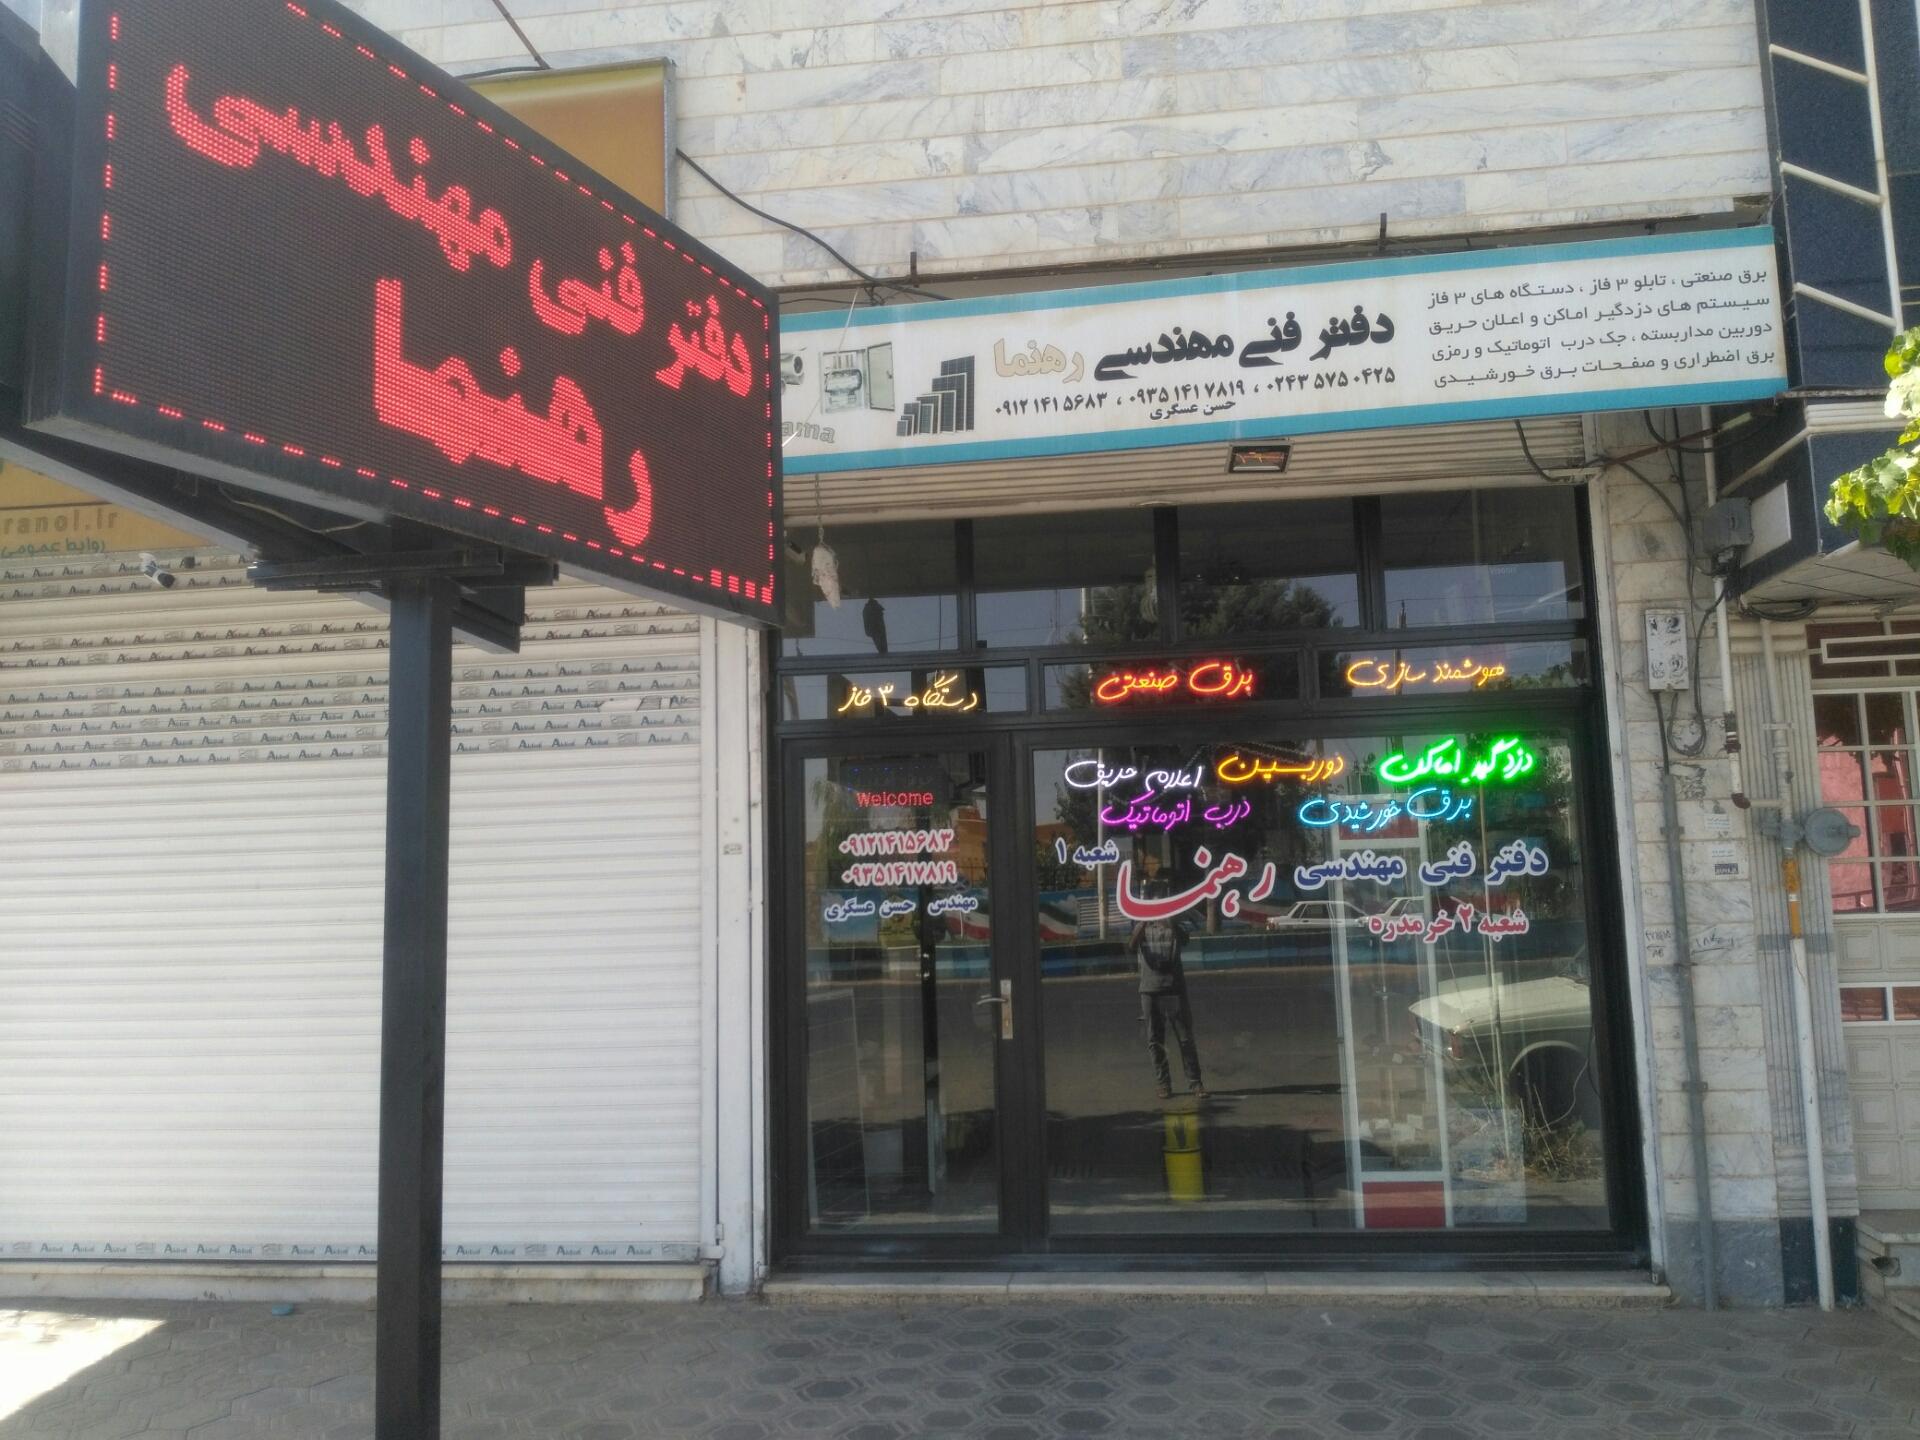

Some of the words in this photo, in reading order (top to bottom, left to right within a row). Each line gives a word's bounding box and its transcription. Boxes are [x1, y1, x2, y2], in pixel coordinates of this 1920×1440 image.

[165, 63, 512, 271] مهندسی
[530, 242, 643, 334] فنی
[1589, 278, 1611, 296] فاز
[1616, 279, 1628, 291] ۳
[1634, 274, 1666, 292] تابلو
[1681, 270, 1733, 287] صنعتی
[1738, 270, 1767, 284] برق
[1427, 292, 1449, 309] فاز
[1454, 292, 1466, 304] ۳
[1471, 289, 1505, 305] های
[1509, 282, 1575, 298] دستگاه
[1594, 302, 1652, 321] دزدگیر
[1657, 300, 1691, 316] های
[1697, 296, 1770, 313] سیستم
[1429, 320, 1477, 335] حریق
[1482, 312, 1524, 330] اعلان
[1530, 314, 1539, 327] و
[1543, 307, 1588, 326] اماکن
[1238, 311, 1302, 368] فنی
[1309, 304, 1395, 361] دفتر
[1599, 332, 1627, 347] جک
[1640, 325, 1714, 343] مداربسته
[1718, 322, 1772, 339] دوربین
[656, 297, 751, 397] دفتر
[1094, 326, 1235, 381] مهندسی
[1432, 345, 1469, 362] رمزی
[1475, 346, 1482, 358] و
[1487, 337, 1551, 356] اتوماتیک
[1561, 336, 1595, 351] درب
[993, 338, 1086, 384] رهنما
[1582, 356, 1655, 372] صفحات
[1661, 357, 1669, 370] و
[1674, 349, 1740, 369] اضطراری
[1746, 349, 1775, 365] برق
[1434, 365, 1535, 388] خورشیدی
[1540, 365, 1578, 380] برق
[374, 279, 652, 547] رهنما
[1150, 402, 1198, 421] عسکری
[1203, 400, 1236, 416] حسن
[65, 536, 106, 554] روابط
[1188, 661, 1254, 697] برق
[1346, 660, 1427, 690] سازی
[1433, 658, 1505, 688] هوشمند
[878, 684, 894, 707] ۳
[903, 675, 979, 711] دستگاه
[1096, 671, 1179, 701] صنعتی
[837, 685, 872, 712] فاز
[1216, 753, 1345, 783] دوربین
[1377, 737, 1463, 785] اماکن
[1460, 737, 1535, 785] دزدگیر
[1064, 760, 1138, 789] حریق
[1144, 765, 1204, 792] اعلام
[1099, 789, 1192, 831] اتوماتیک
[1203, 799, 1252, 828] درب
[1405, 786, 1473, 821] برق
[1298, 799, 1402, 832] خورشیدی
[1072, 838, 1120, 871] شعبه
[1418, 840, 1476, 887] فنی
[1484, 839, 1549, 885] دفتر
[1294, 850, 1408, 890] مهندسی
[1116, 846, 1276, 921] رهنما
[824, 897, 876, 922] عسکری
[879, 898, 916, 919] حسن
[927, 894, 978, 918] مهندس
[1456, 903, 1475, 934] ۲
[1477, 908, 1531, 942] شعبه
